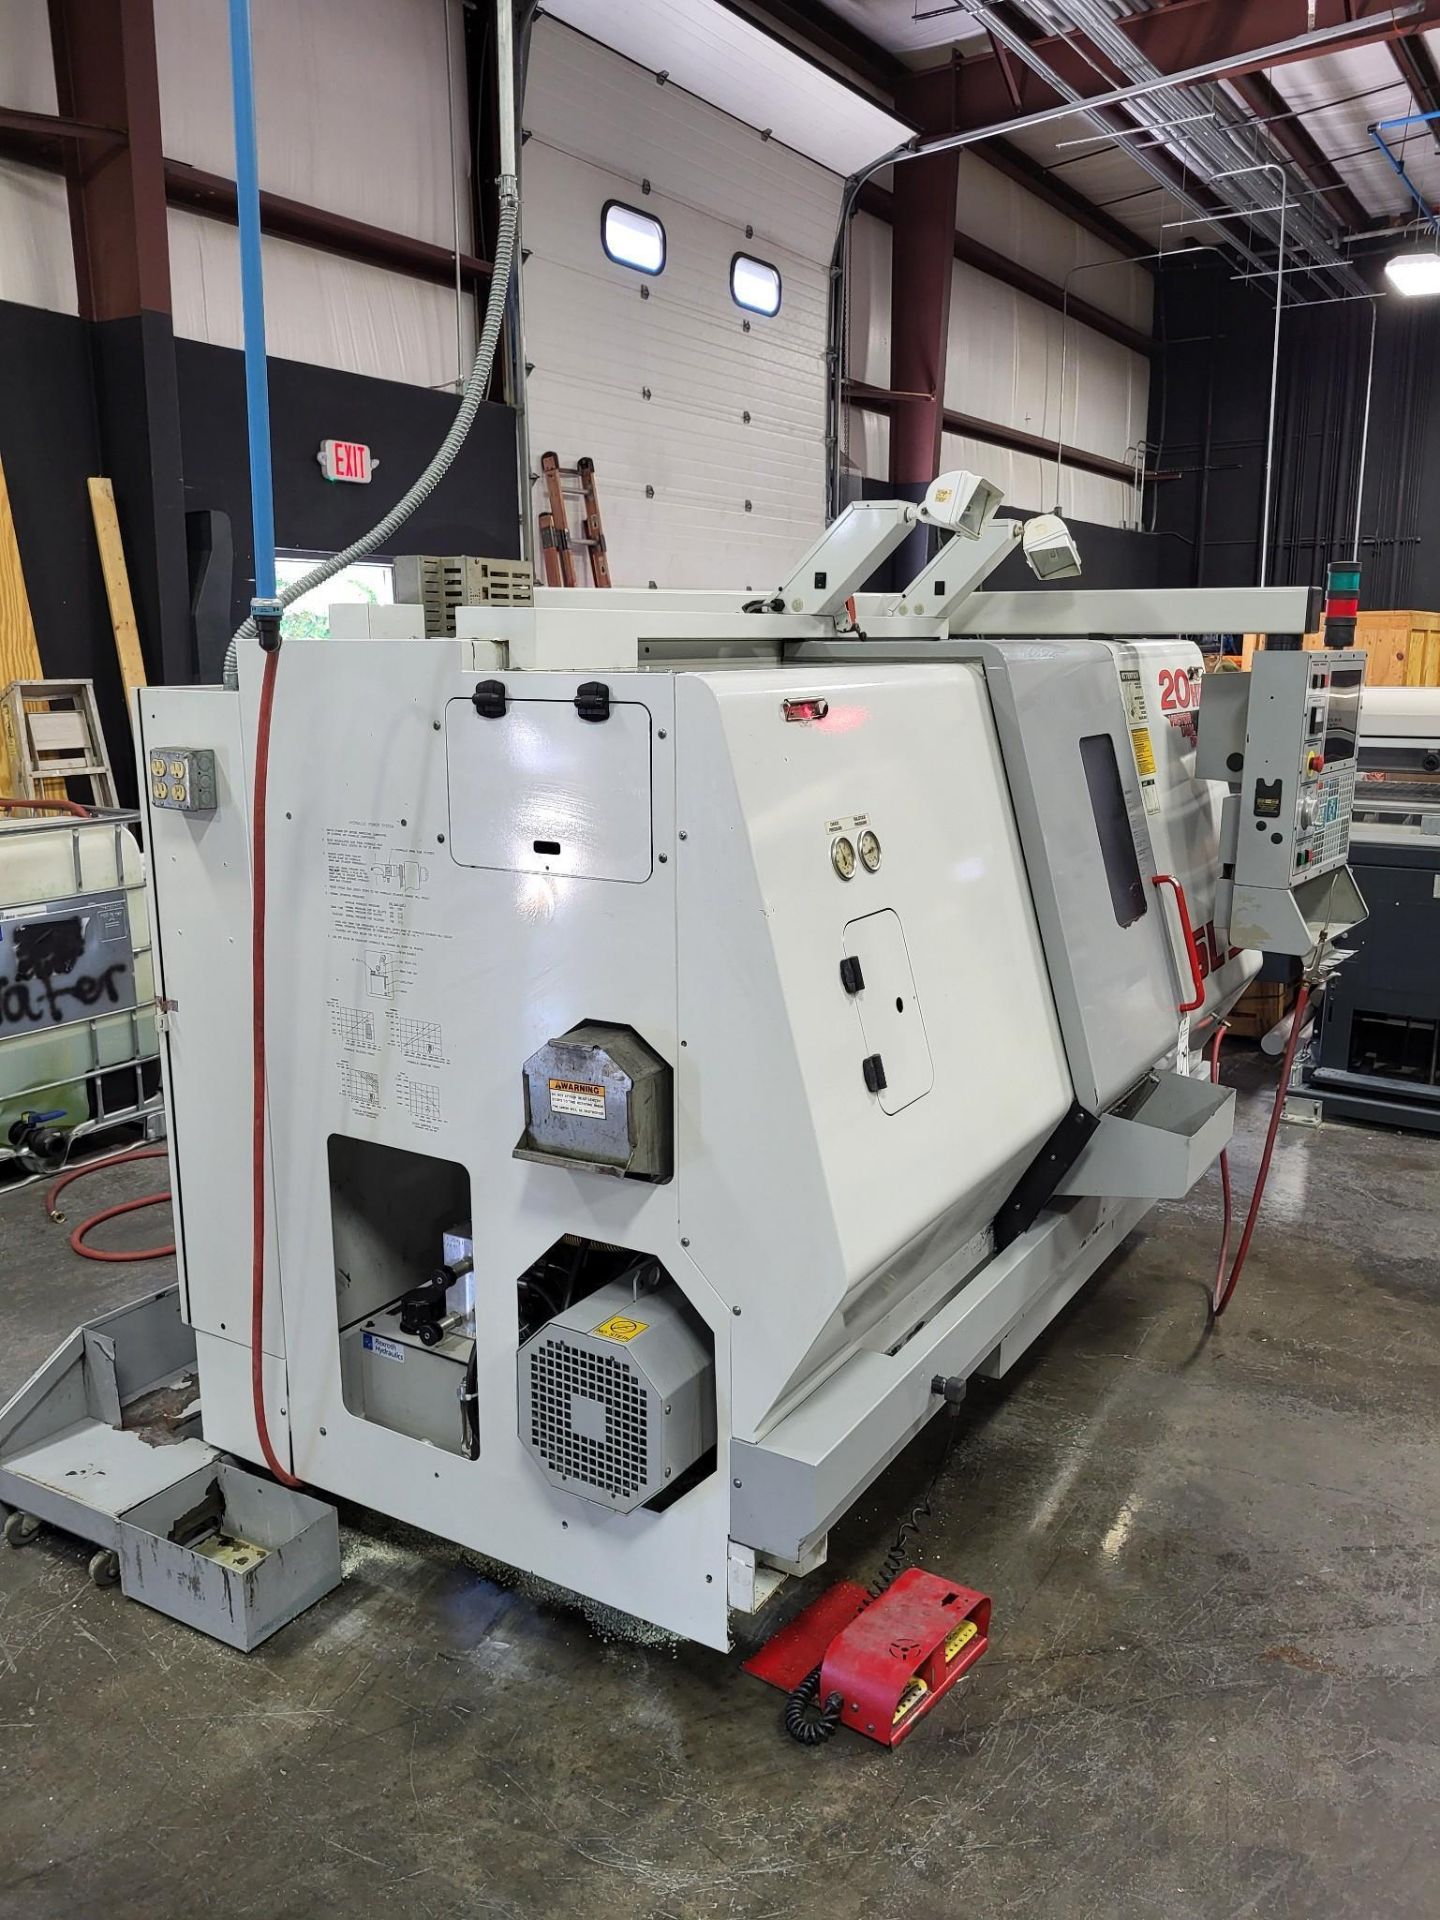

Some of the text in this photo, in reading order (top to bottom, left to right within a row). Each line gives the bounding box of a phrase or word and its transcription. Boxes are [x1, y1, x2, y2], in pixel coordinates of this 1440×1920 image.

[335, 443, 364, 478] EXIT
[0, 964, 126, 1022] ater
[560, 1082, 600, 1095] WARNING
